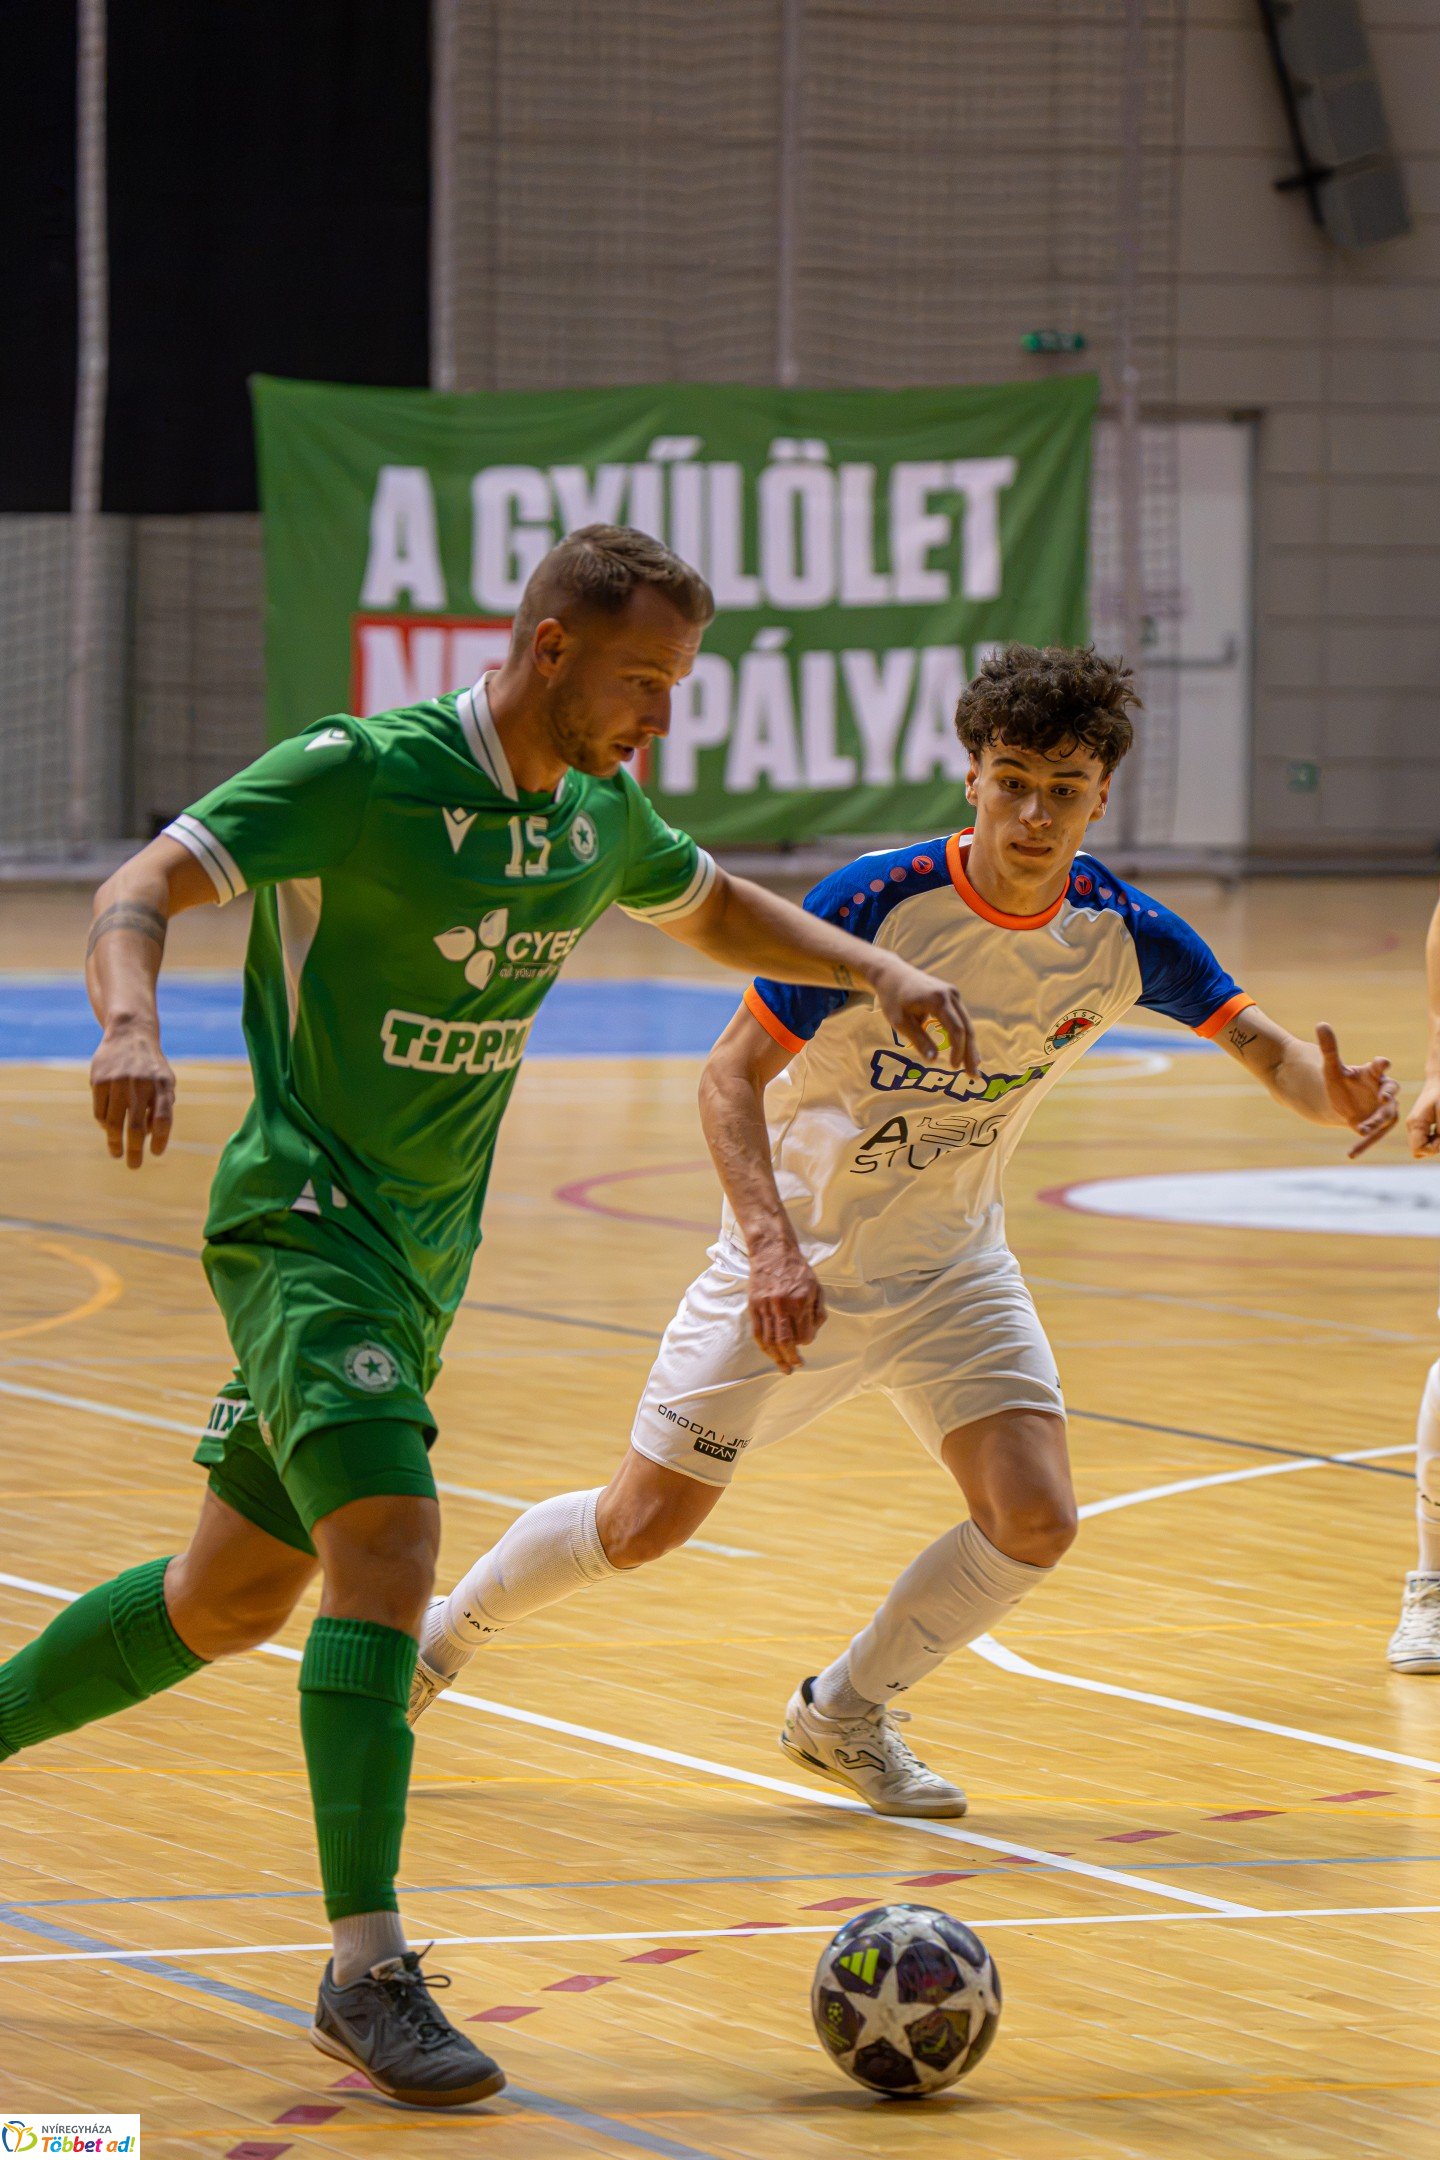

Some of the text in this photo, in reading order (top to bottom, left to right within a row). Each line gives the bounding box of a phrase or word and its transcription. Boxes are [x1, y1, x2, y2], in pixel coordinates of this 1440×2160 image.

[360, 433, 1017, 613] A GYŰLÖLET
[660, 625, 1003, 795] PÁLYA
[504, 815, 552, 878] 15
[850, 1143, 951, 1174] STU
[463, 1611, 506, 1633] JAK
